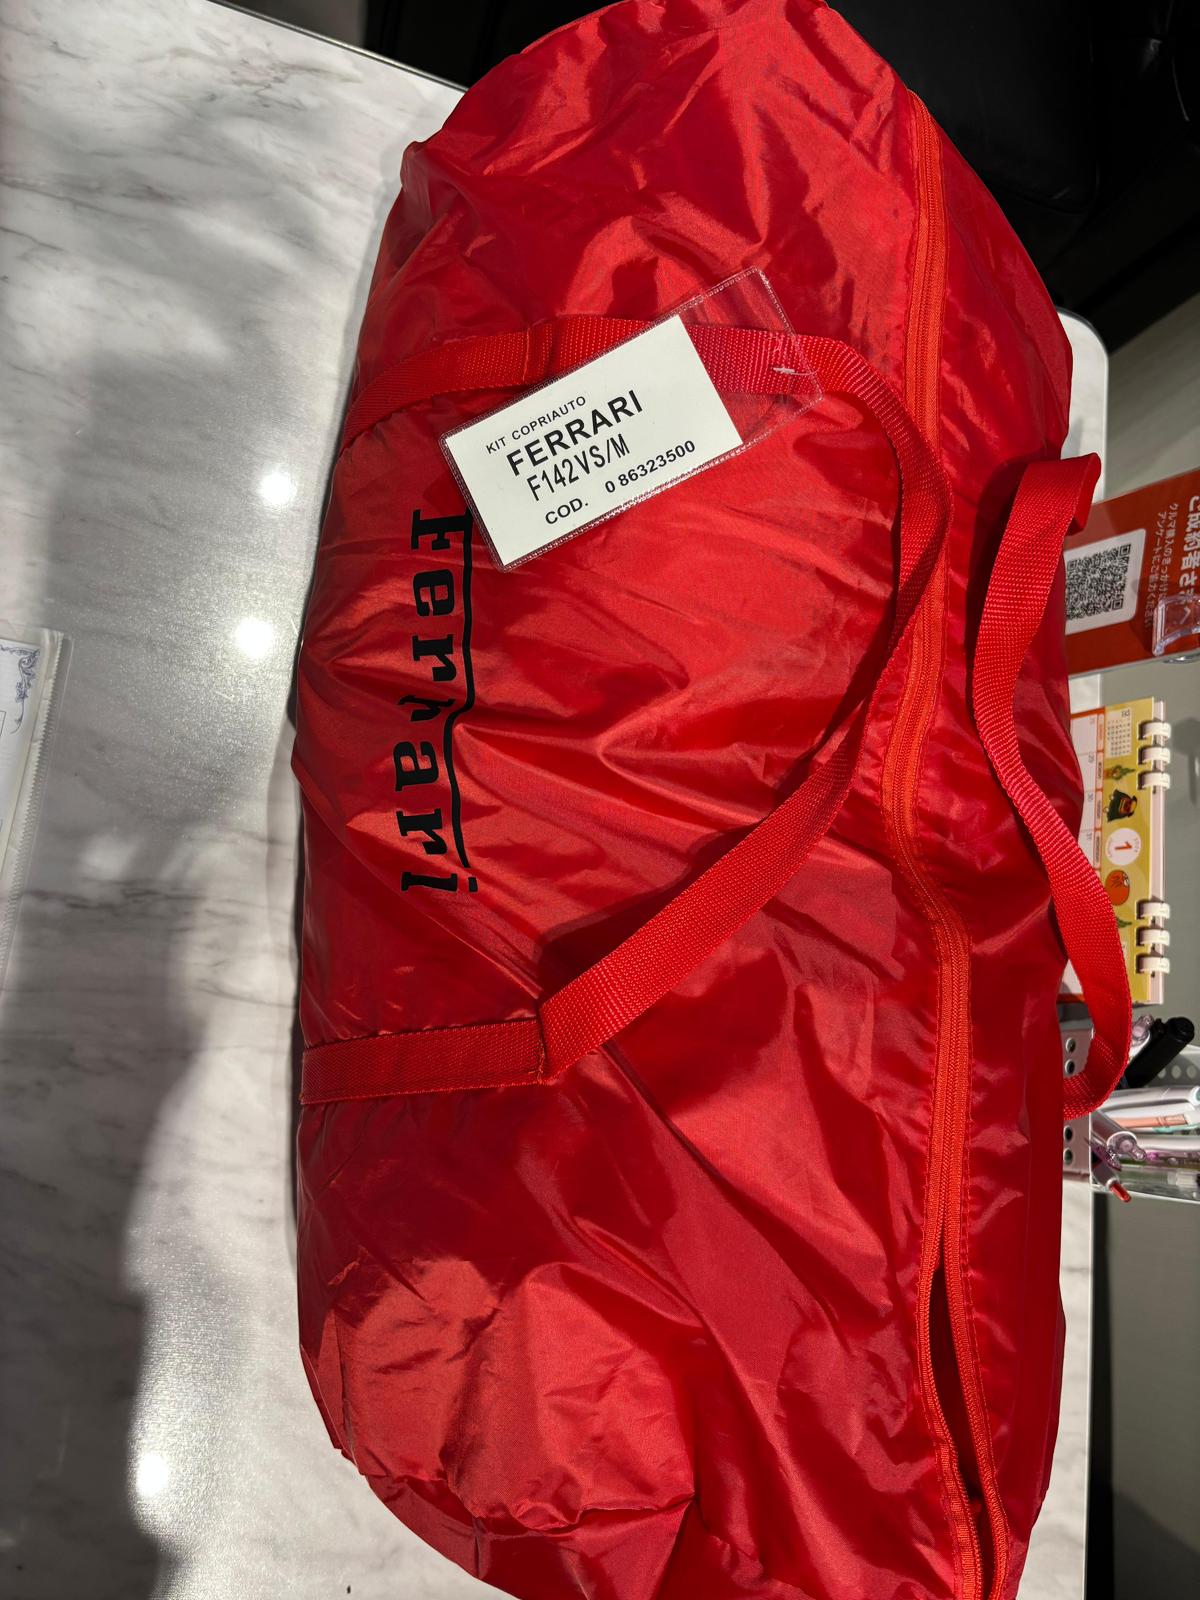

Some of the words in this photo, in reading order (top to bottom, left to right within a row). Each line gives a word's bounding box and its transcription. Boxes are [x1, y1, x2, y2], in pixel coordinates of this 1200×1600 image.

[485, 436, 507, 455] KIT
[511, 396, 587, 441] COPRIAUTO
[506, 390, 643, 477] FERRARI
[526, 433, 631, 502] F142VS/M
[545, 500, 590, 526] COD.
